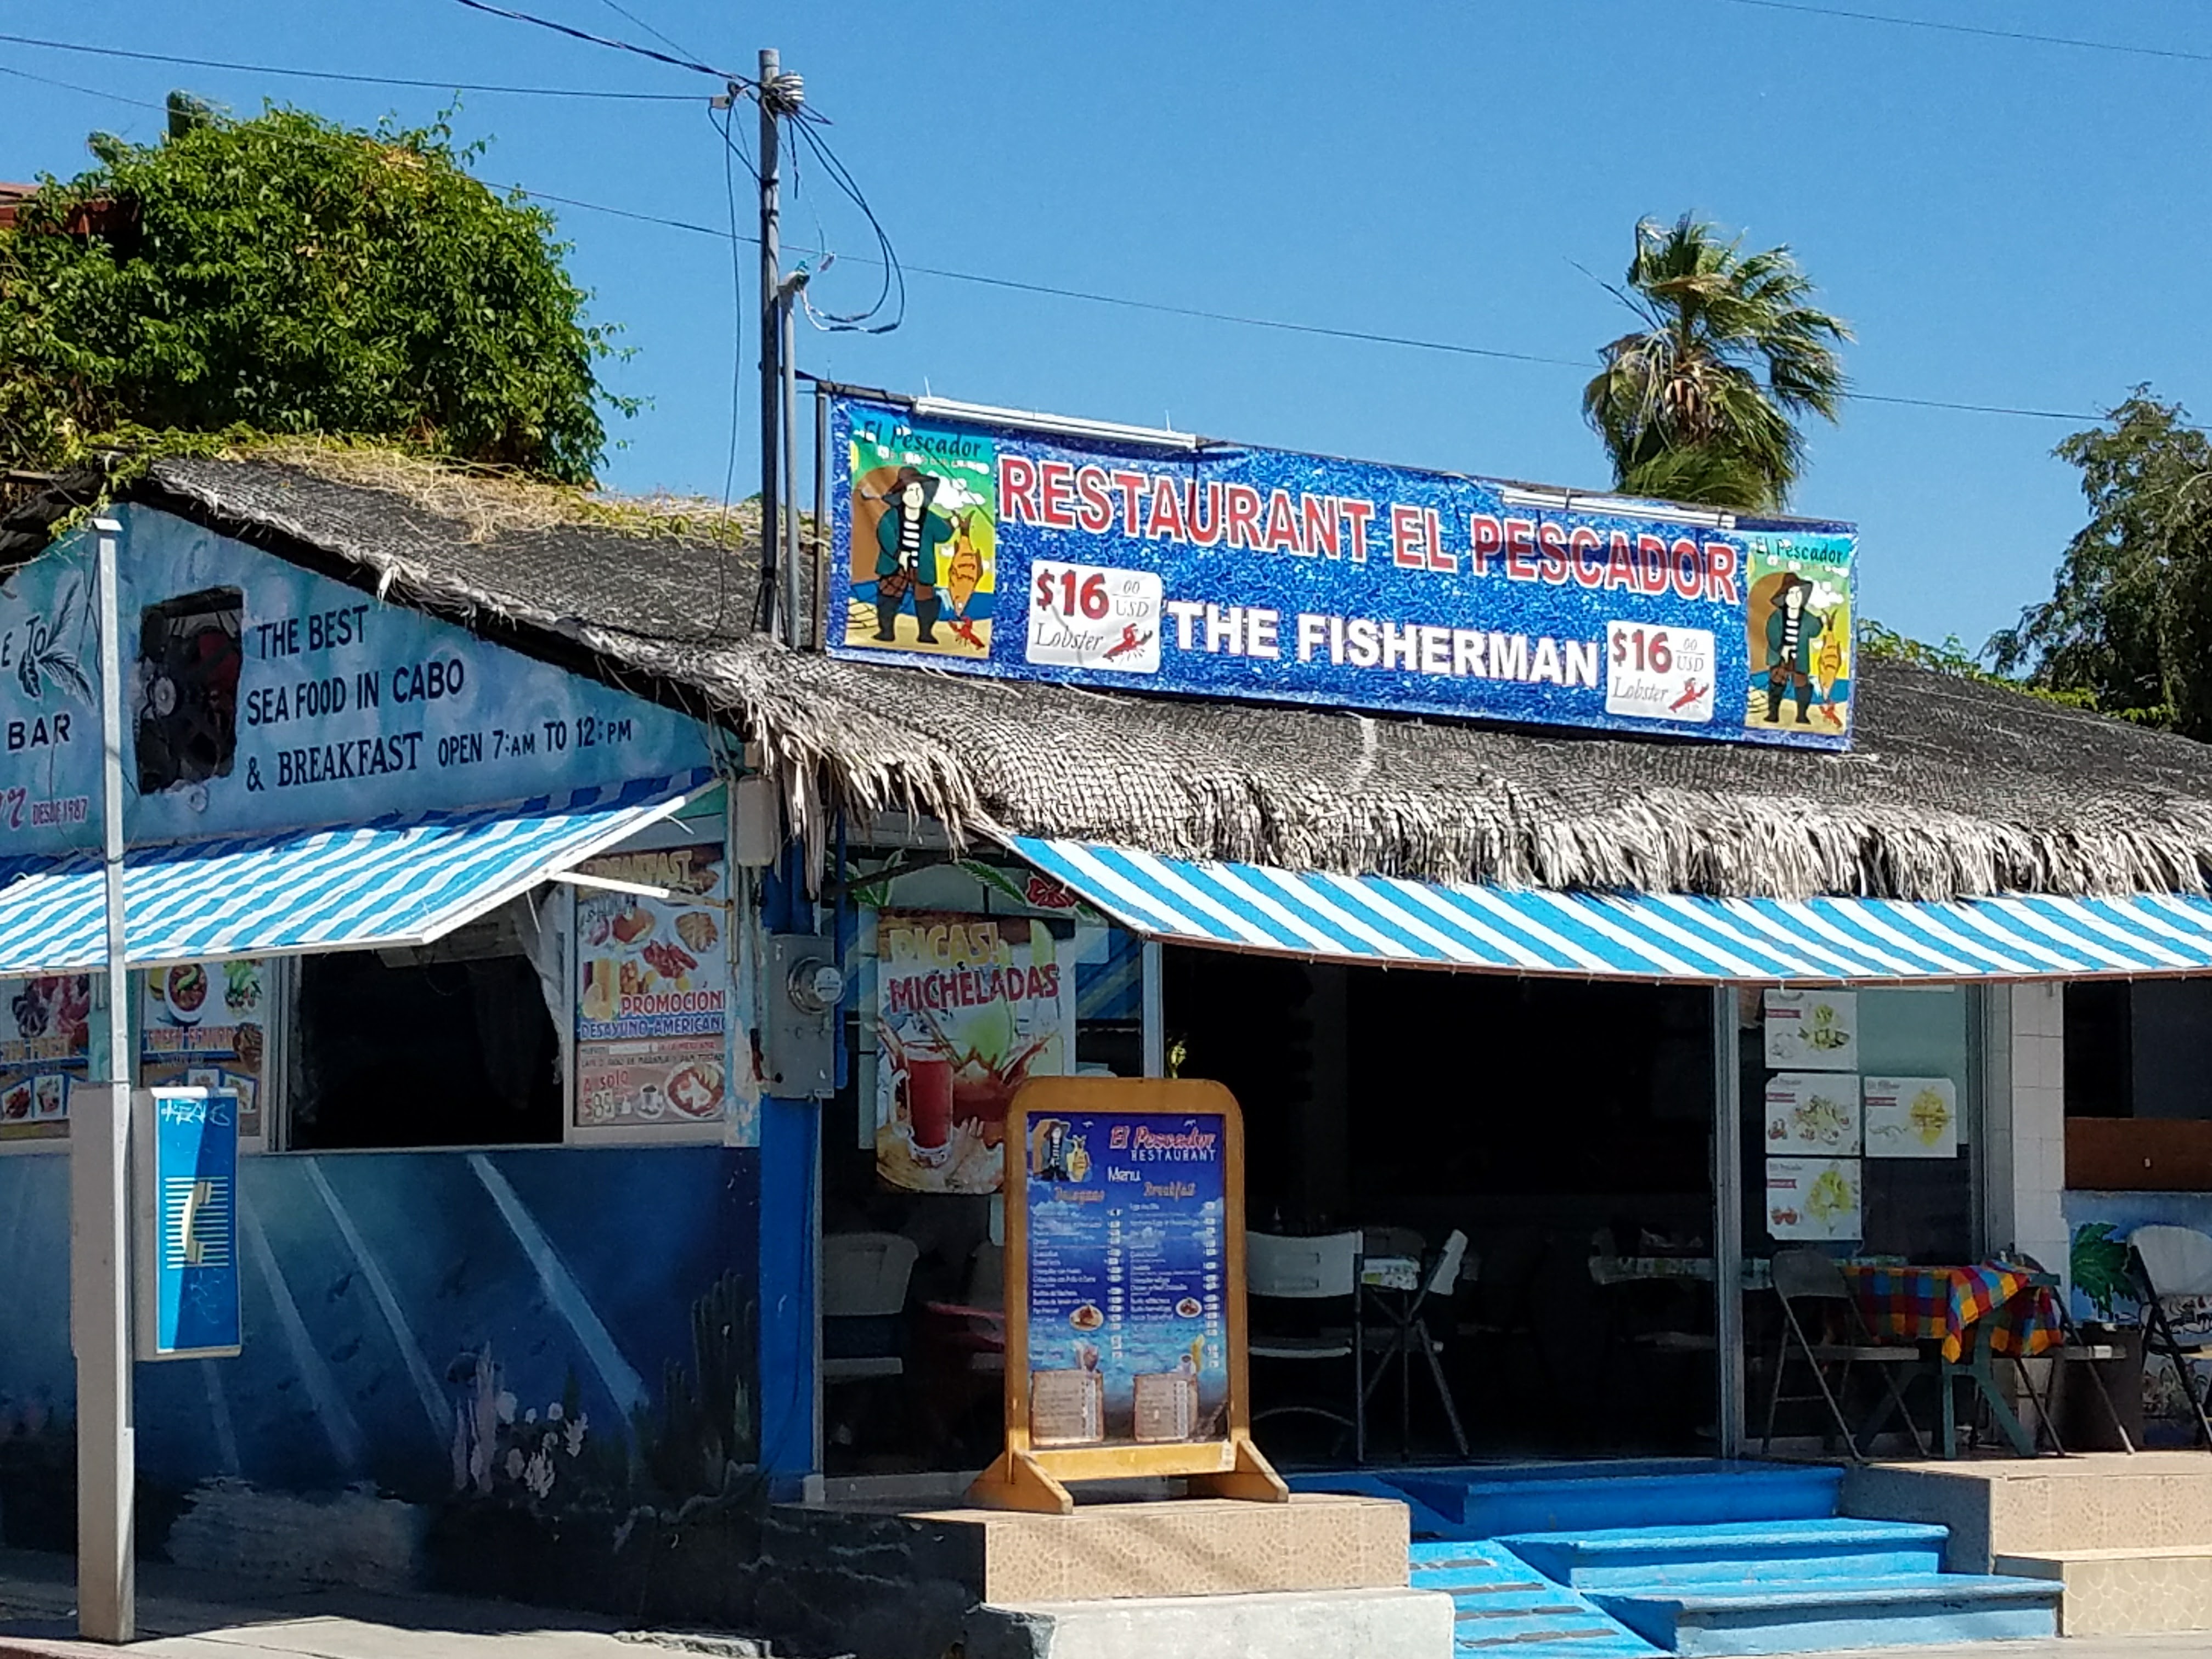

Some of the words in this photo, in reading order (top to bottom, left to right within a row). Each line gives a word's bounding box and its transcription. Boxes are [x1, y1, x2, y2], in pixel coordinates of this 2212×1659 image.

[890, 424, 981, 457] Pescador
[997, 454, 1373, 562] RESTAURANT
[1392, 504, 1457, 573] EL
[1471, 515, 1740, 605] PESCADOR
[1776, 539, 1844, 564] Pescador
[1036, 568, 1110, 620] $16
[1116, 599, 1149, 618] USD
[257, 618, 300, 659] THE
[309, 605, 369, 651] BEST
[1034, 622, 1104, 651] Lobster
[1163, 600, 1279, 659] THE
[1297, 613, 1599, 689] FISHERMAN
[1612, 628, 1673, 674] $16
[1677, 655, 1704, 672] USD
[296, 677, 346, 719] FOOD
[357, 671, 380, 710] IN
[393, 659, 464, 703] CABO
[1611, 676, 1669, 702] Lobster
[8, 714, 71, 751] BAR
[246, 756, 265, 792] &
[276, 731, 424, 787] BREAKFAST
[438, 732, 483, 768] OPEN
[544, 720, 567, 752] TO
[620, 989, 725, 1015] PROMOCION
[889, 963, 1059, 1013] MICHELADAS
[582, 1020, 648, 1038] DESAYUNO
[1109, 1125, 1130, 1149] El
[1133, 1126, 1216, 1150] Pescador
[1130, 1149, 1216, 1161] RESTAURANT
[1107, 1166, 1141, 1182] Menu
